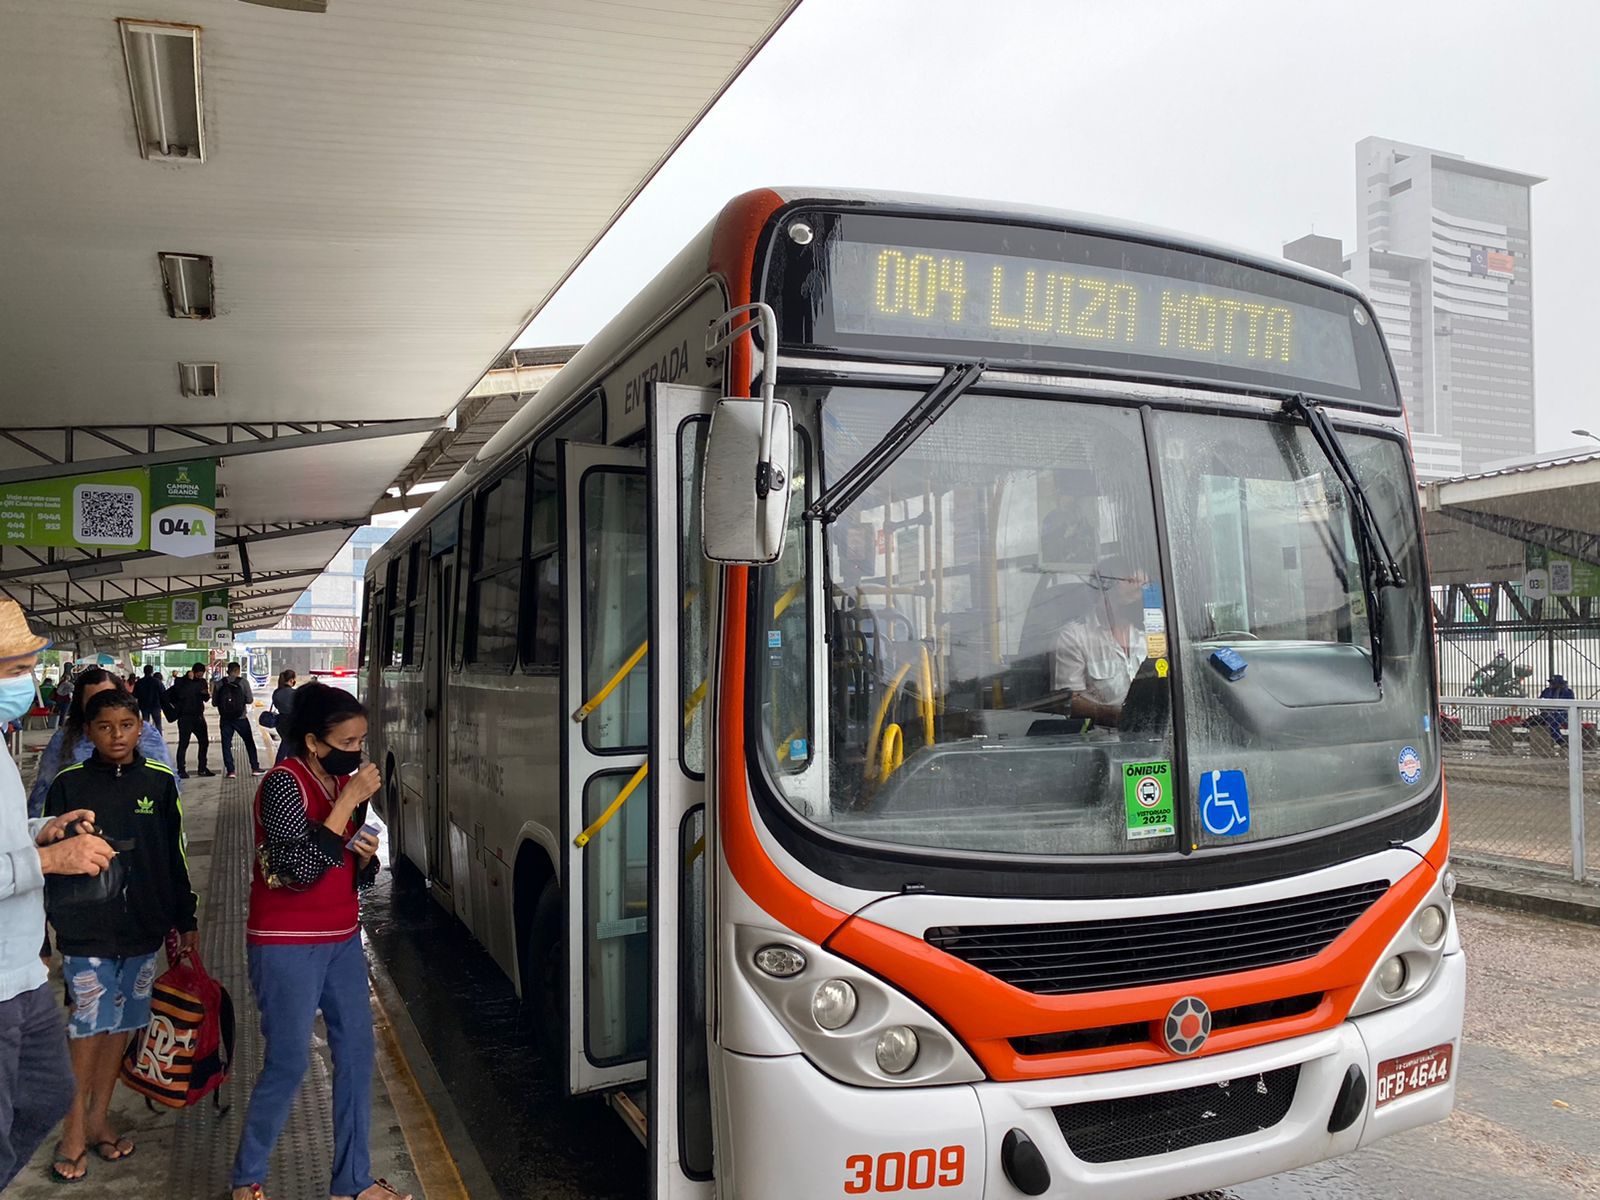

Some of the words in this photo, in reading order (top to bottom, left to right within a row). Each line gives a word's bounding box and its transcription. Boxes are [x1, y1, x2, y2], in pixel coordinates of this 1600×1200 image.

[876, 249, 966, 322] 004
[990, 265, 1140, 343] LUIZA
[1159, 288, 1293, 362] MOTTA
[624, 339, 689, 415] ENTRADA
[168, 488, 199, 496] GRANDE
[158, 518, 208, 536] 04A
[205, 613, 225, 622] 03A
[1126, 764, 1167, 776] ÔNIBUS
[1143, 815, 1167, 824] 2022
[843, 1144, 966, 1195] 3009
